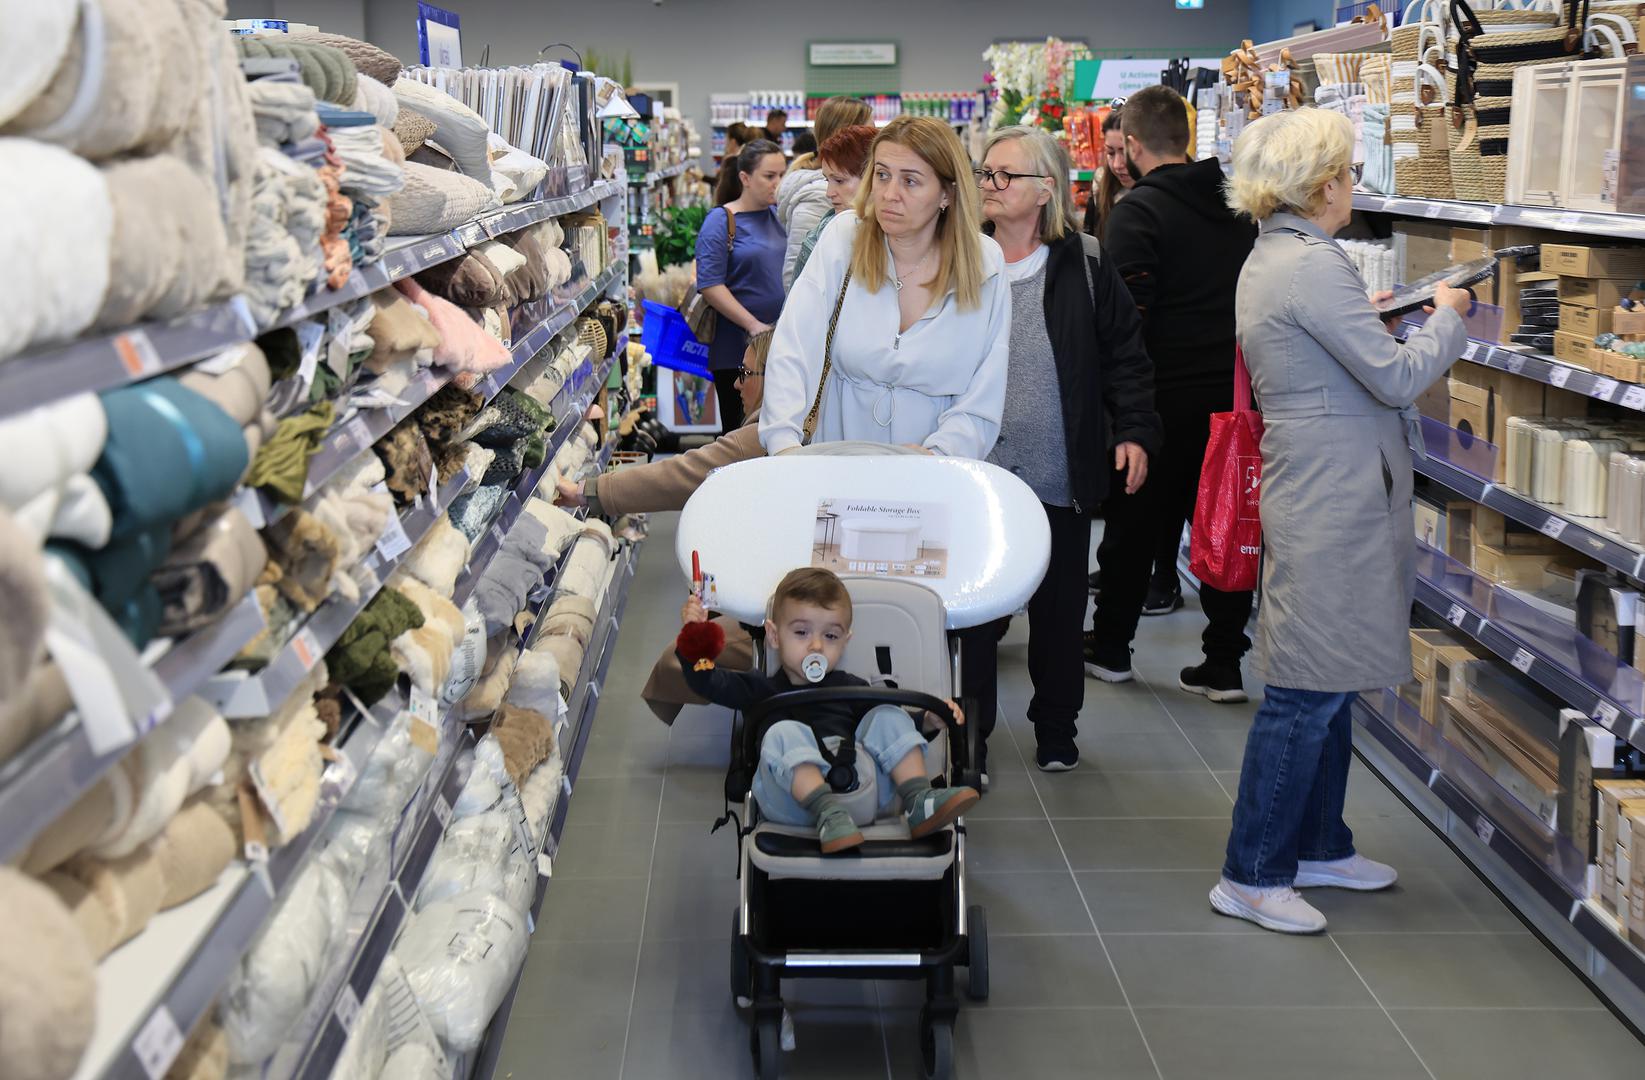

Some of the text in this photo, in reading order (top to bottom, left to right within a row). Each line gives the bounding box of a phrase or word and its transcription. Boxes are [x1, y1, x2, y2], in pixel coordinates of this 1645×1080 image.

[847, 505, 920, 516] Foldable Storage Box
